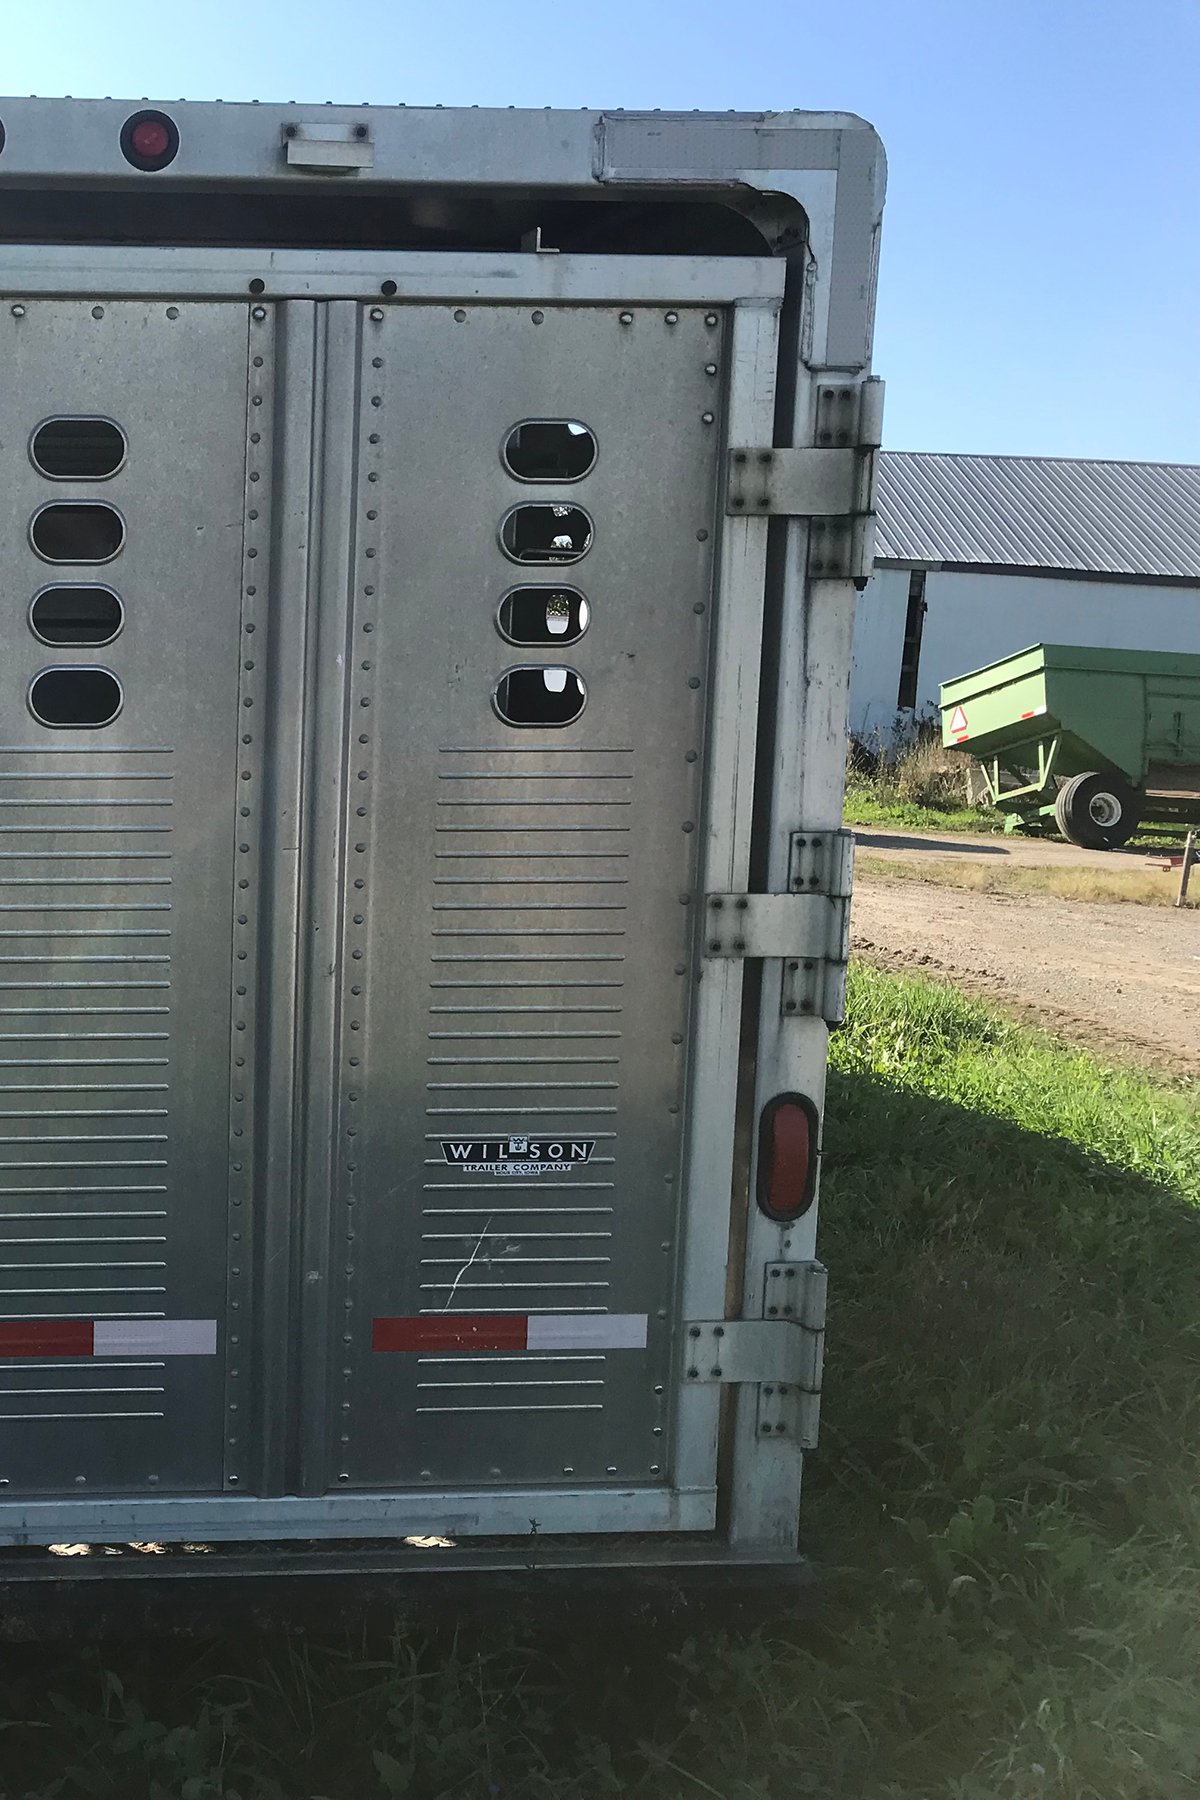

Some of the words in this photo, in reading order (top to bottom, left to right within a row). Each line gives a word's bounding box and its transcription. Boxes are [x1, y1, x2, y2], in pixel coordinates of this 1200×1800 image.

[450, 1144, 587, 1159] WILSON
[465, 1163, 508, 1171] TRAILER
[513, 1163, 571, 1171] COMPANY
